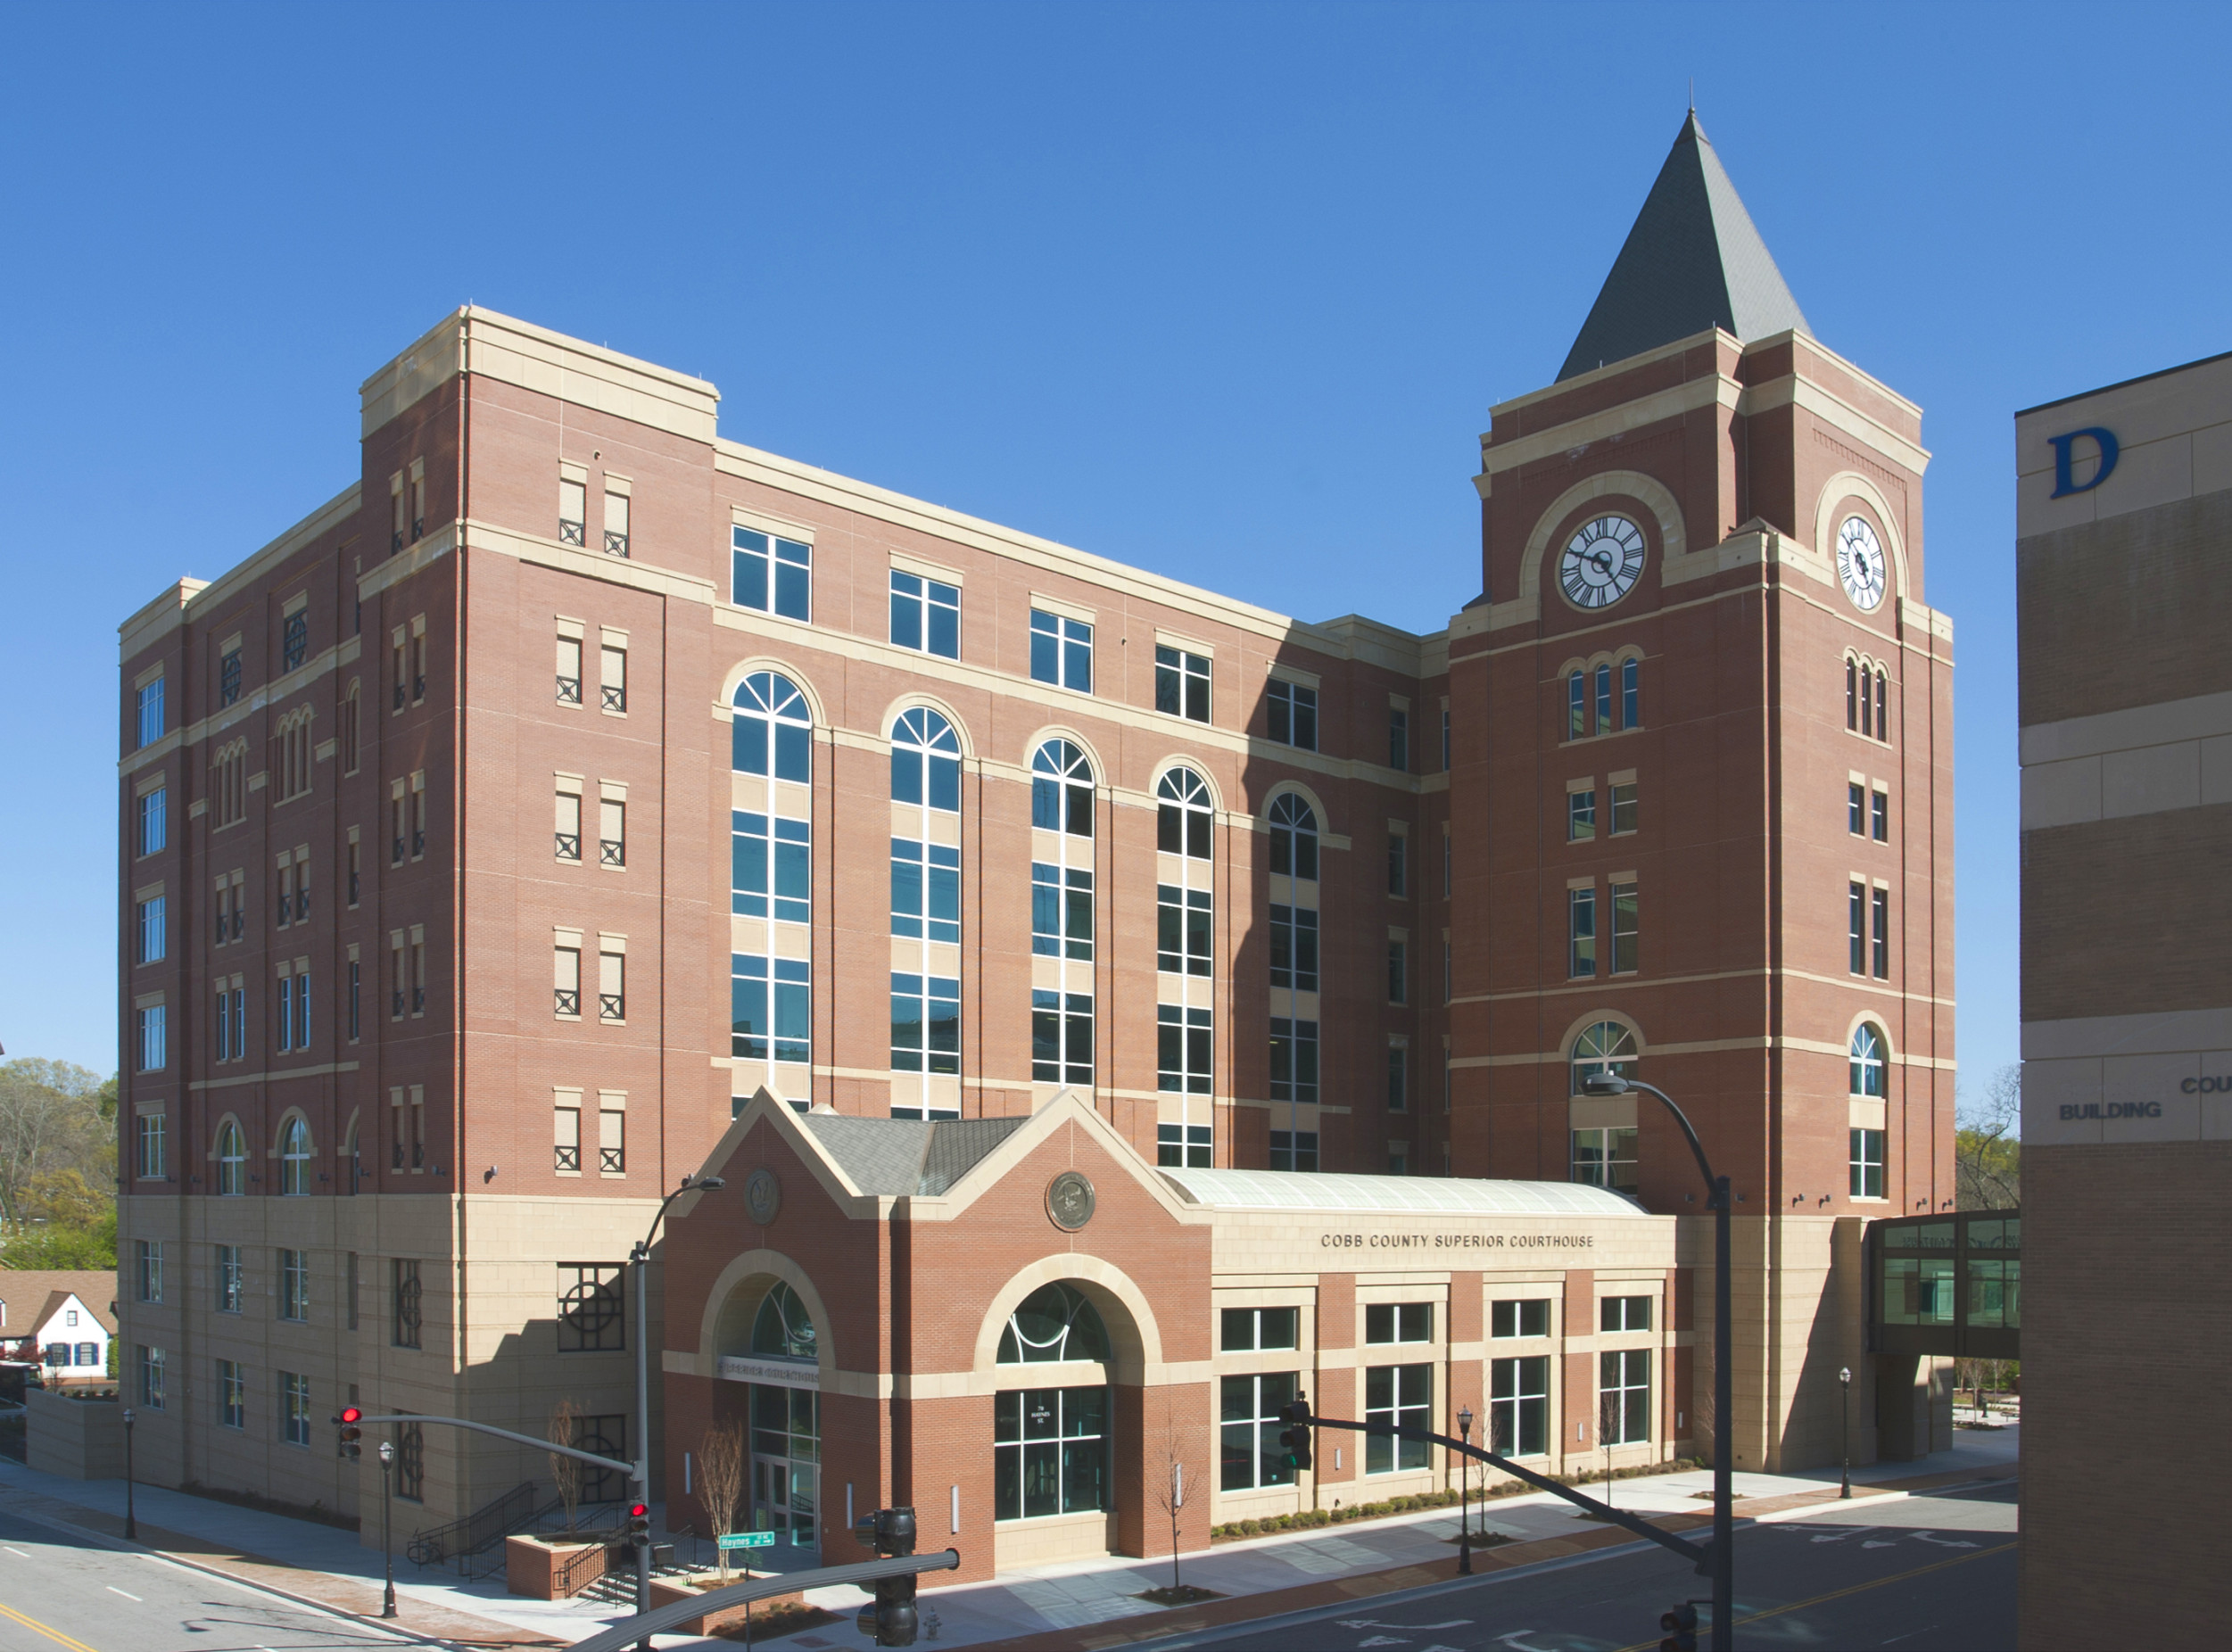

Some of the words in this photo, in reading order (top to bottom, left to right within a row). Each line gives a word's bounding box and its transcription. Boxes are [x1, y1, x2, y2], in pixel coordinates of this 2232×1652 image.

[2047, 426, 2119, 500] D
[2059, 1101, 2162, 1121] BUILDING
[1321, 1235, 1363, 1248] COBB
[1369, 1235, 1428, 1248] COUNTY
[1434, 1235, 1504, 1248] SUPERIOR
[1509, 1235, 1593, 1248] COURTHOUSE
[722, 1538, 750, 1548] Haynes
